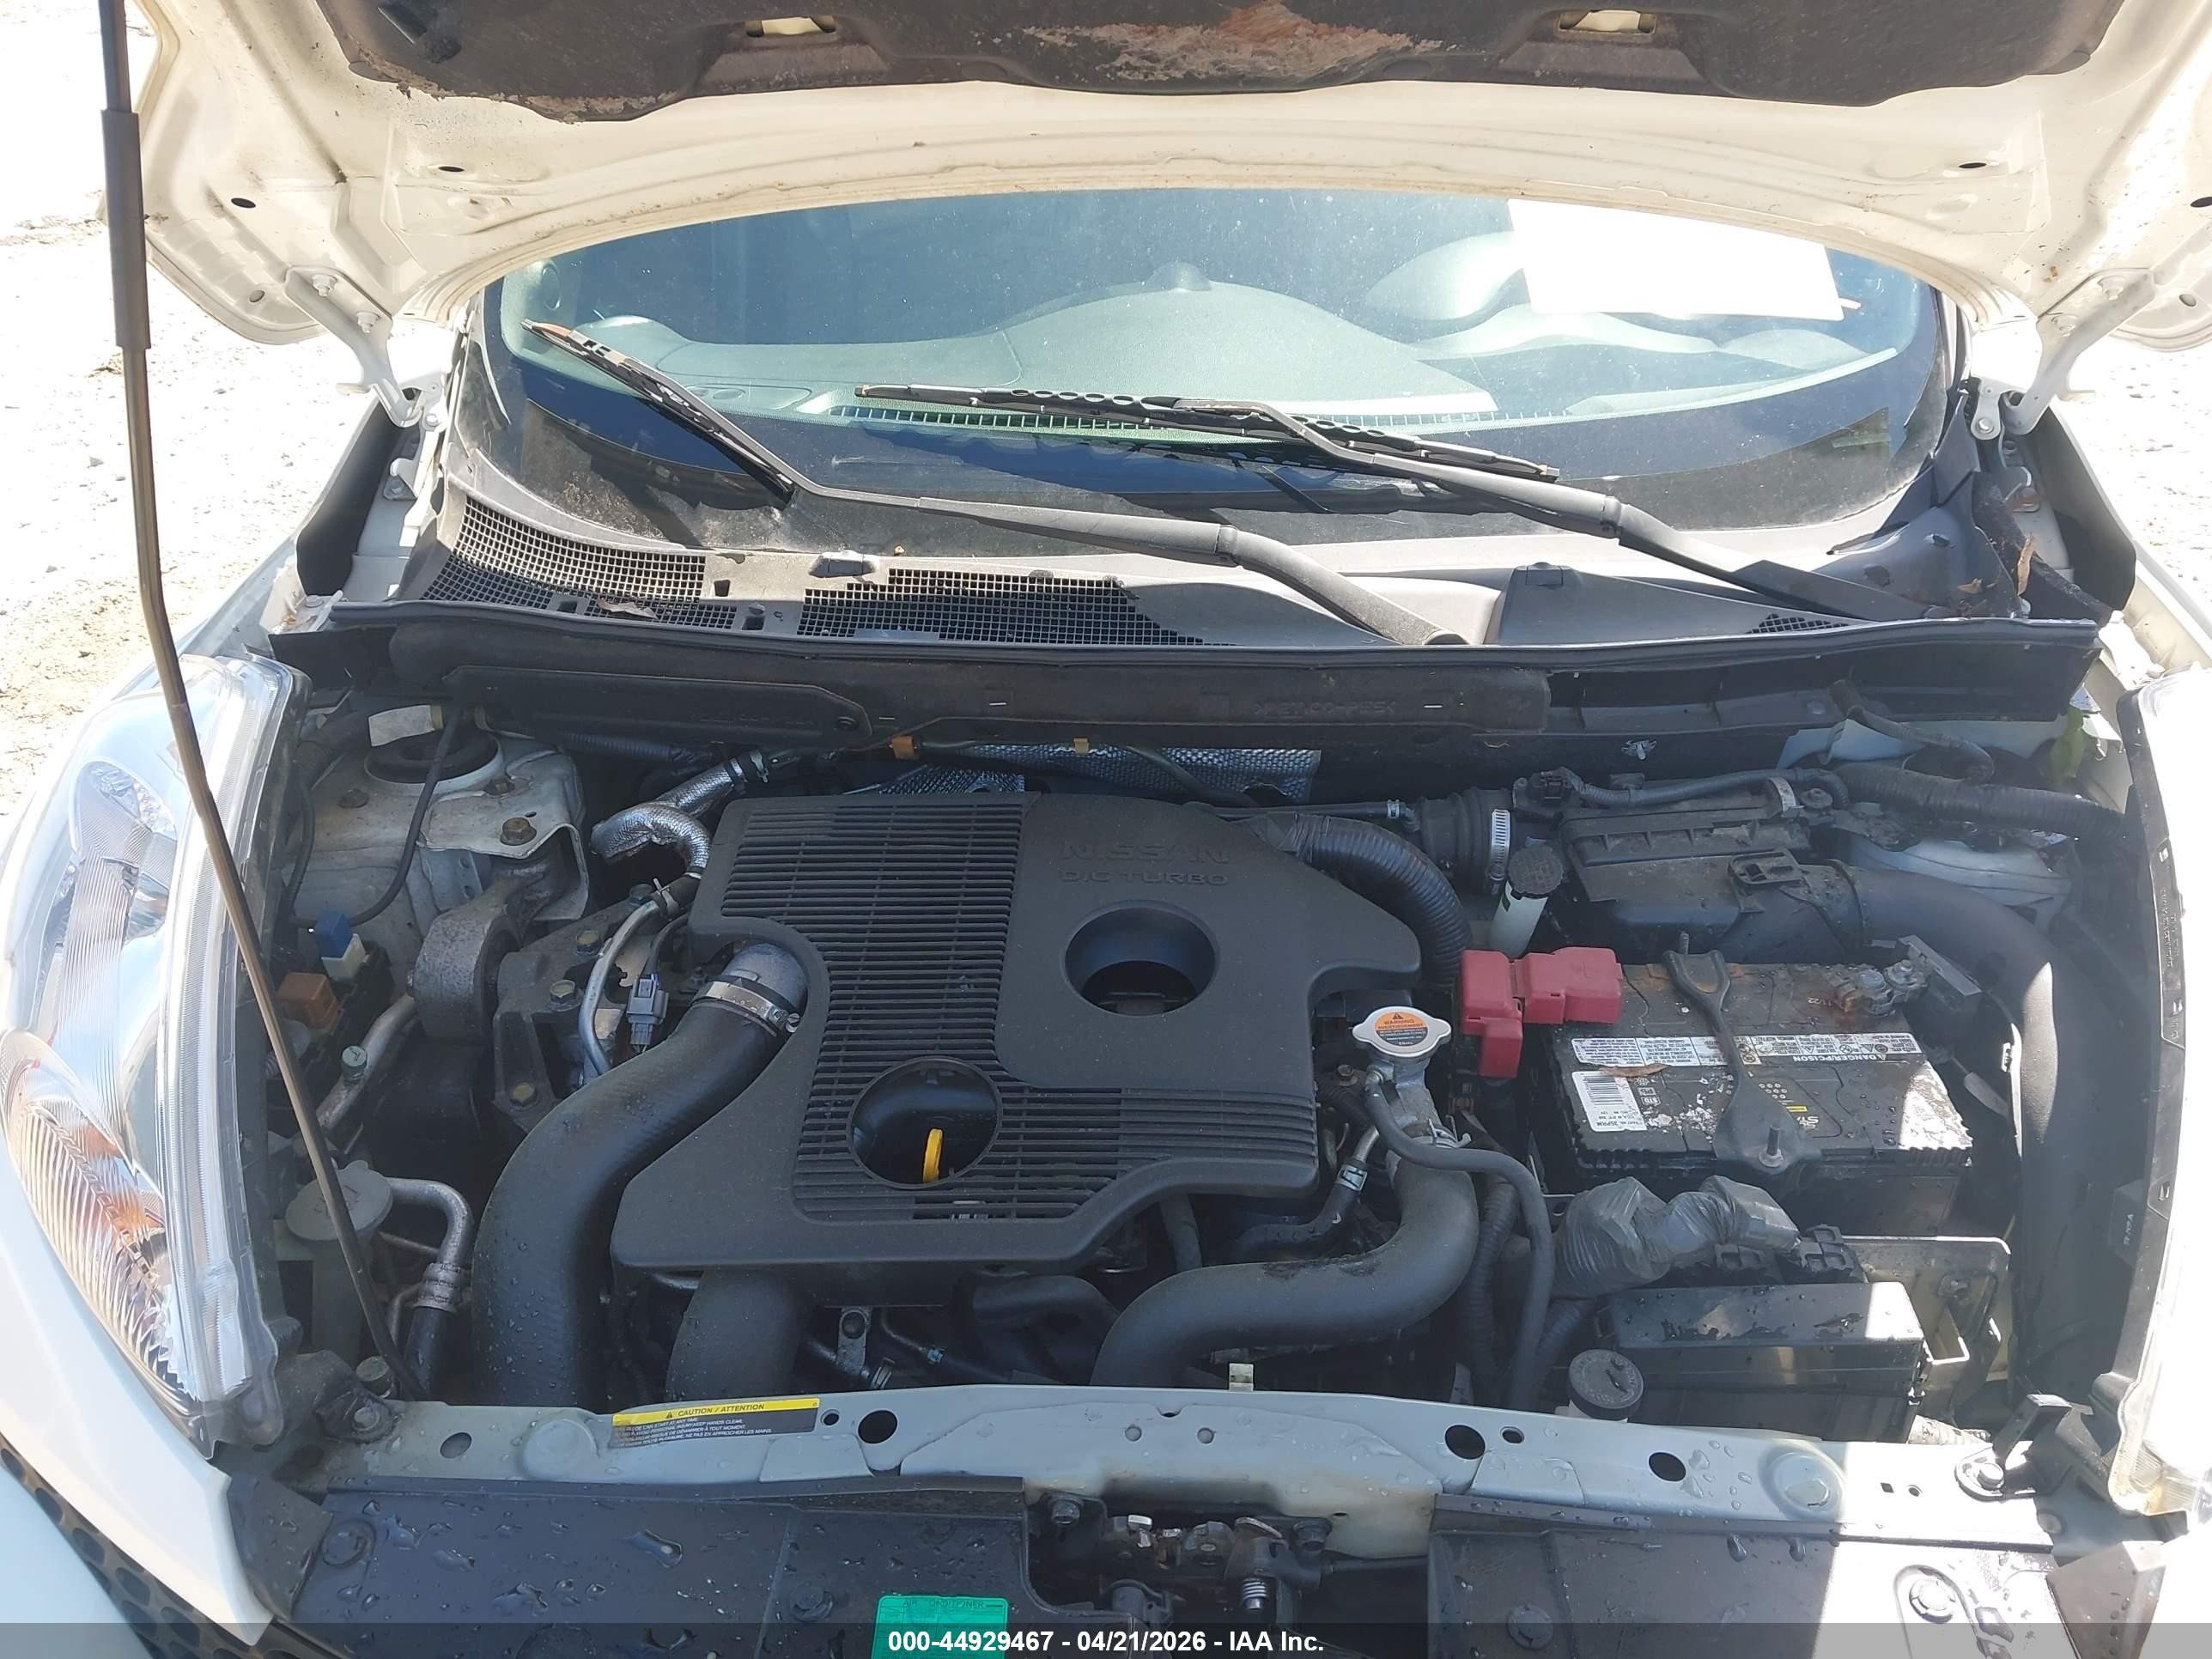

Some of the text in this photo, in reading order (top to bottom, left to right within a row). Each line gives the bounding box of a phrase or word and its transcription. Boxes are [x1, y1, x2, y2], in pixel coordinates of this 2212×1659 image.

[1061, 842, 1231, 865] NISSAN
[1120, 872, 1230, 886] TURBO
[678, 1408, 712, 1417] CAUTION
[720, 1403, 764, 1413] ATTENTION
